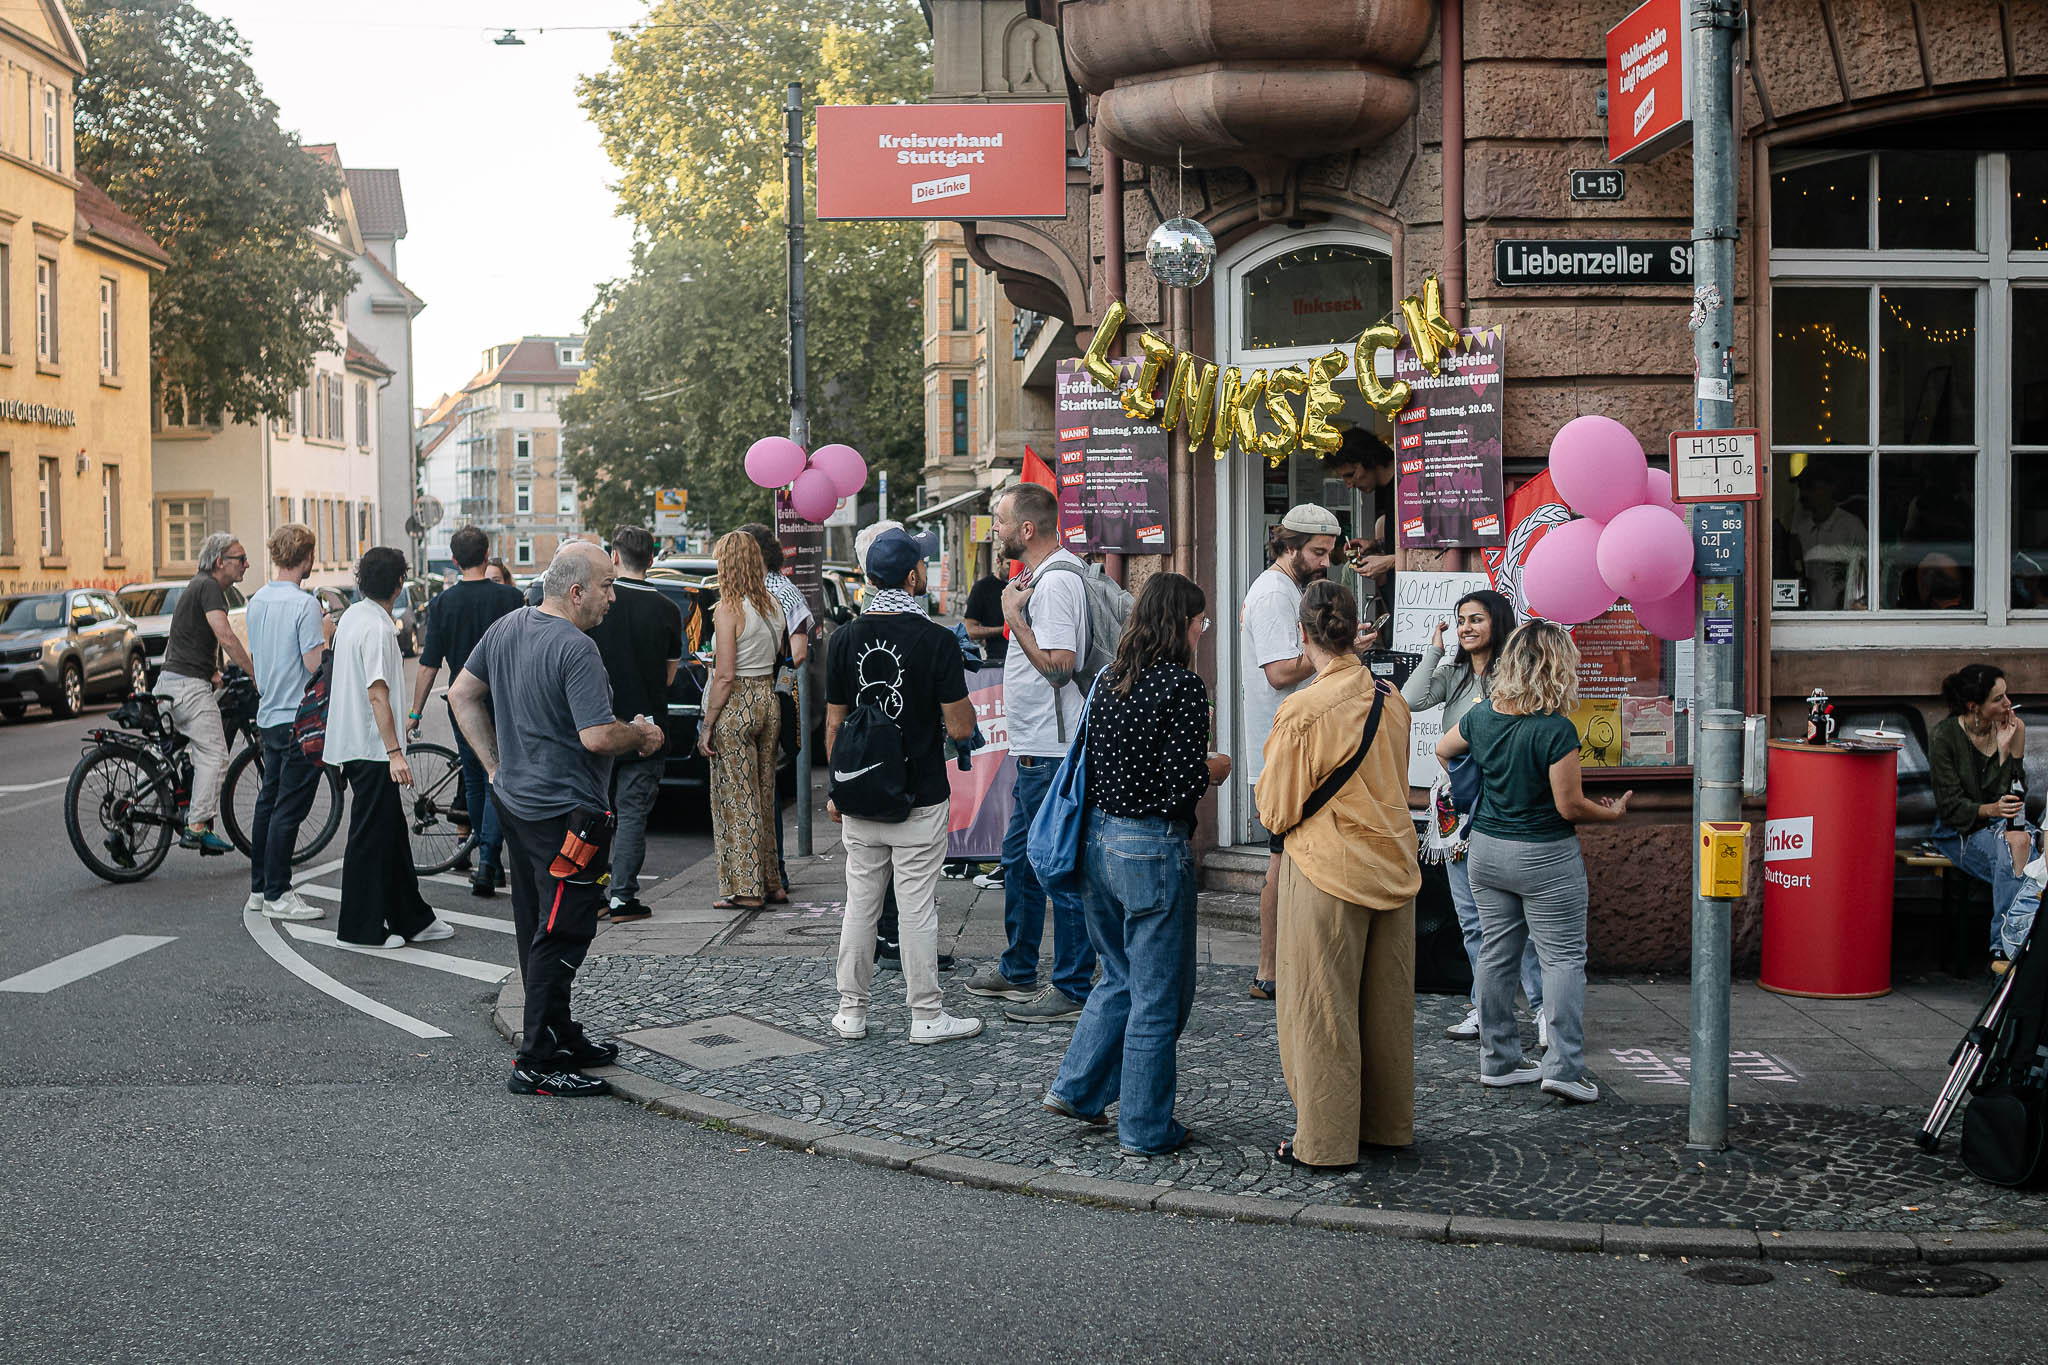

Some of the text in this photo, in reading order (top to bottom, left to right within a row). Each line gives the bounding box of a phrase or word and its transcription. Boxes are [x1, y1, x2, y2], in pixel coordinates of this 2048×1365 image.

[1620, 27, 1667, 72] Wahlkreisbüro
[1619, 66, 1636, 94] Luigi
[879, 133, 1003, 149] Kreisverband
[897, 150, 985, 168] Stuttgart
[916, 181, 967, 199] Die Linke
[1577, 176, 1617, 194] 1-15
[1507, 246, 1654, 276] Liebenzeller
[1400, 403, 1495, 422] WANN? Samstag, 20.09.
[1060, 426, 1160, 440] WANN? Samstag, 20.09.
[1402, 436, 1419, 447] WO?
[1063, 452, 1081, 462] WO?
[1402, 460, 1422, 473] WAS?
[1063, 474, 1084, 485] WAS?
[1701, 519, 1742, 530] S 863
[1399, 578, 1454, 606] KOMMT
[1396, 612, 1414, 633] ES
